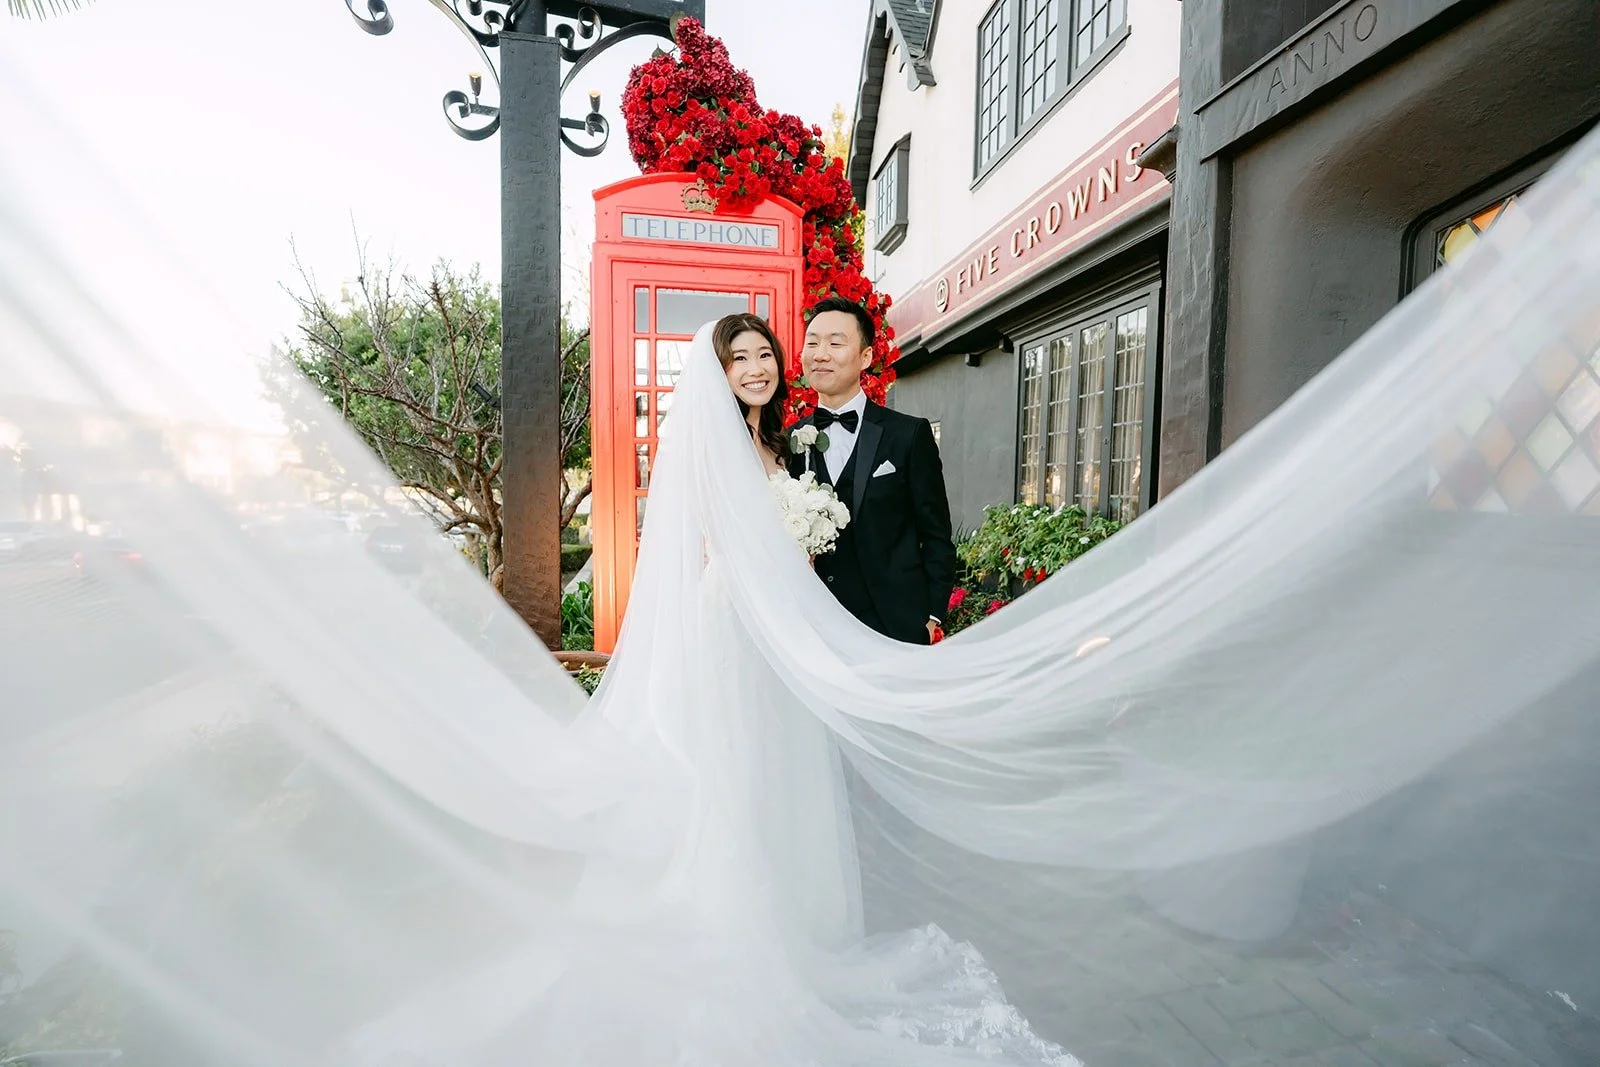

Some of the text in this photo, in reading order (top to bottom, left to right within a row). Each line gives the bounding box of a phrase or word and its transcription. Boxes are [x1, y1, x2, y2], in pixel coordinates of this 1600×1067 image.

[1266, 4, 1378, 103] ANNO
[628, 217, 773, 247] TELEPHONE
[956, 141, 1145, 294] FIVE CROWNS
